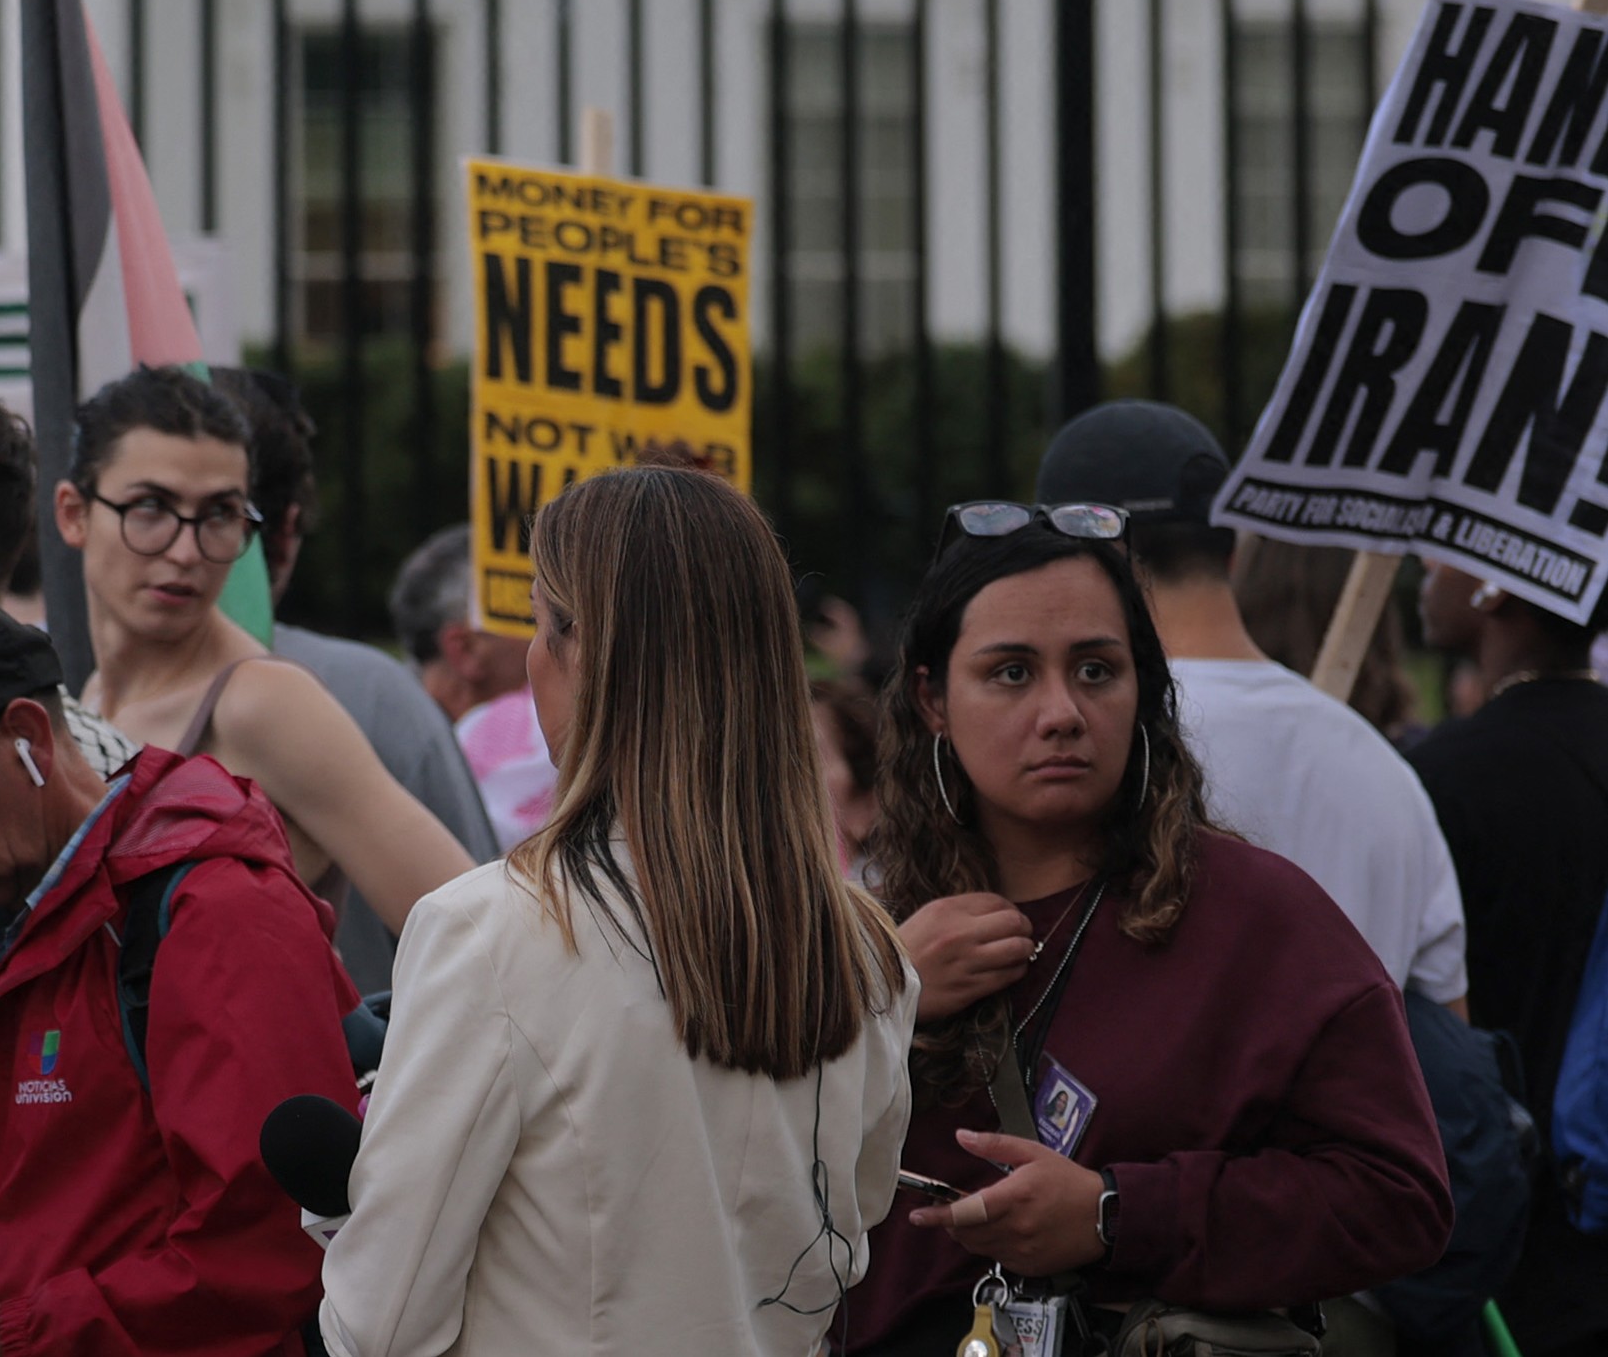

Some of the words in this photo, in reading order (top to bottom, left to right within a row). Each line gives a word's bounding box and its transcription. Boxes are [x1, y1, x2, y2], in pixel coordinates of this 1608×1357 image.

[1394, 1, 1608, 178] HAN
[477, 174, 633, 220] MONEY
[647, 198, 744, 235] FOR
[1356, 156, 1608, 302] OF
[479, 209, 740, 279] PEOPLE'S
[484, 252, 738, 414] NEEDS
[486, 411, 594, 456] NOT
[1234, 484, 1301, 525] PARTY
[1300, 493, 1337, 525] FOR
[1431, 512, 1451, 541] &
[1454, 516, 1588, 597] LIBERATION
[15, 1090, 73, 1105] univision
[18, 1079, 66, 1094] NOTICIAS
